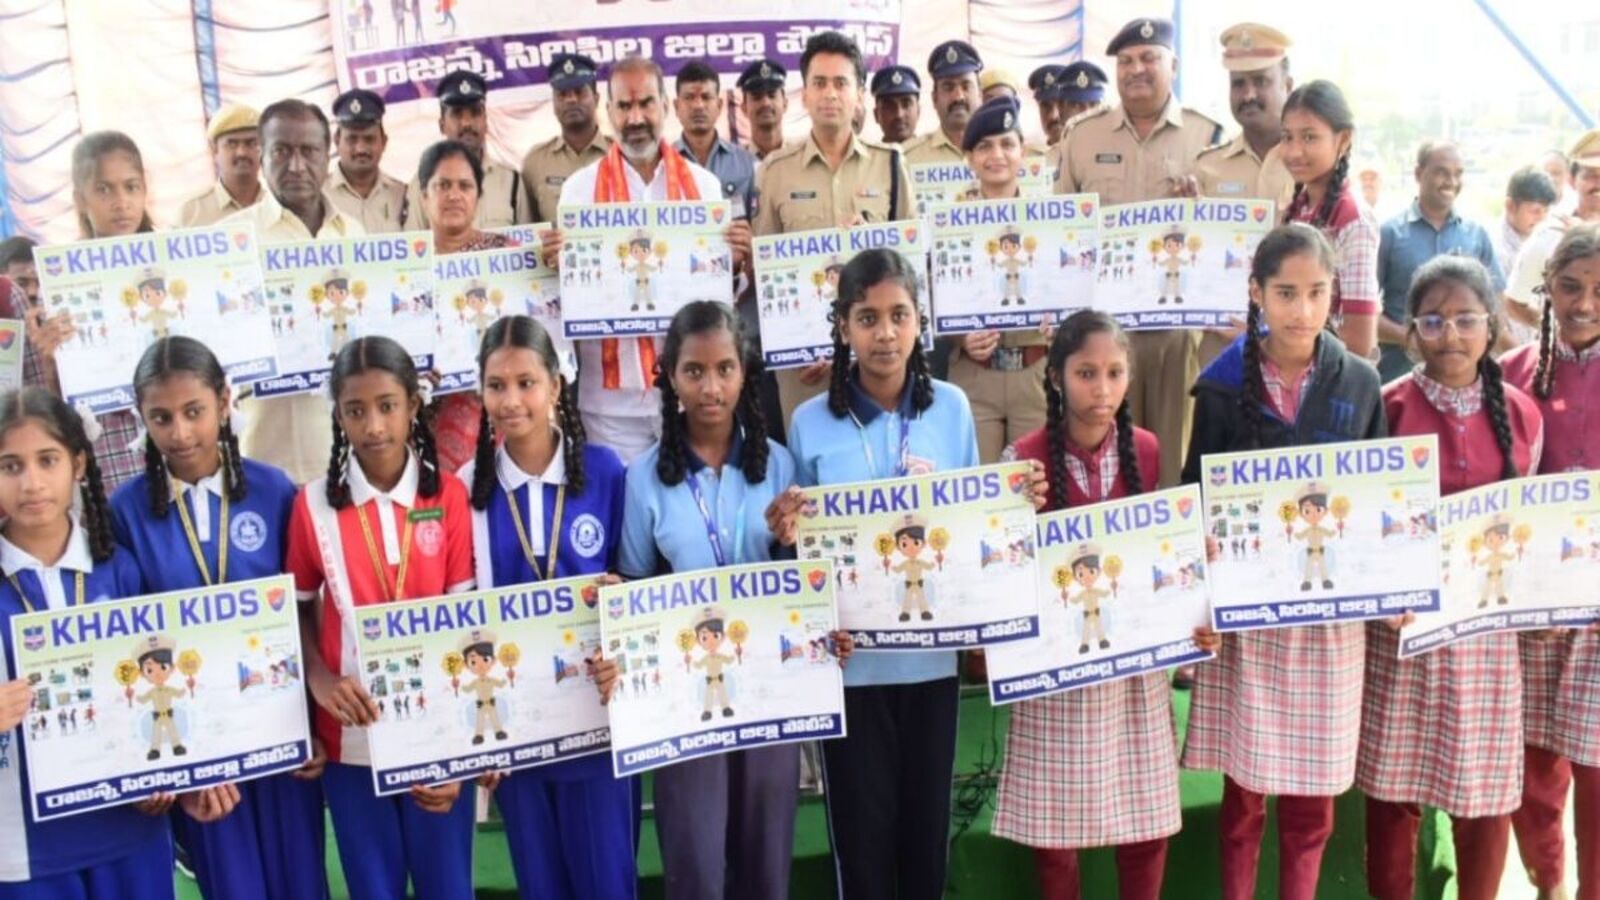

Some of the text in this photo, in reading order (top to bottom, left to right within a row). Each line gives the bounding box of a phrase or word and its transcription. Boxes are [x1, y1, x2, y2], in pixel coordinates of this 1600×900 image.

[355, 45, 503, 90] రాజన్న
[664, 32, 766, 64] జిల్లా
[927, 165, 974, 182] KHAK
[580, 206, 707, 228] KHAKI KIDS
[950, 200, 1076, 226] KHAKI KIDS
[1118, 203, 1247, 227] KHAKI KIDS
[66, 231, 229, 274] KHAKI KIDS
[266, 239, 409, 271] KHAKI KIDS
[774, 226, 901, 259] KHAKI KIDS
[434, 251, 537, 280] HAKI KIDS
[1232, 446, 1405, 485] KHAKI KIDS
[824, 472, 1001, 517] KHAKI KIDS
[1521, 479, 1590, 506] KIDS
[1037, 499, 1171, 548] AKI KIDS
[629, 568, 801, 616] KHAKI KIDS
[51, 588, 259, 647] KHAKI KIDS
[386, 586, 575, 638] KHAKI KIDS
